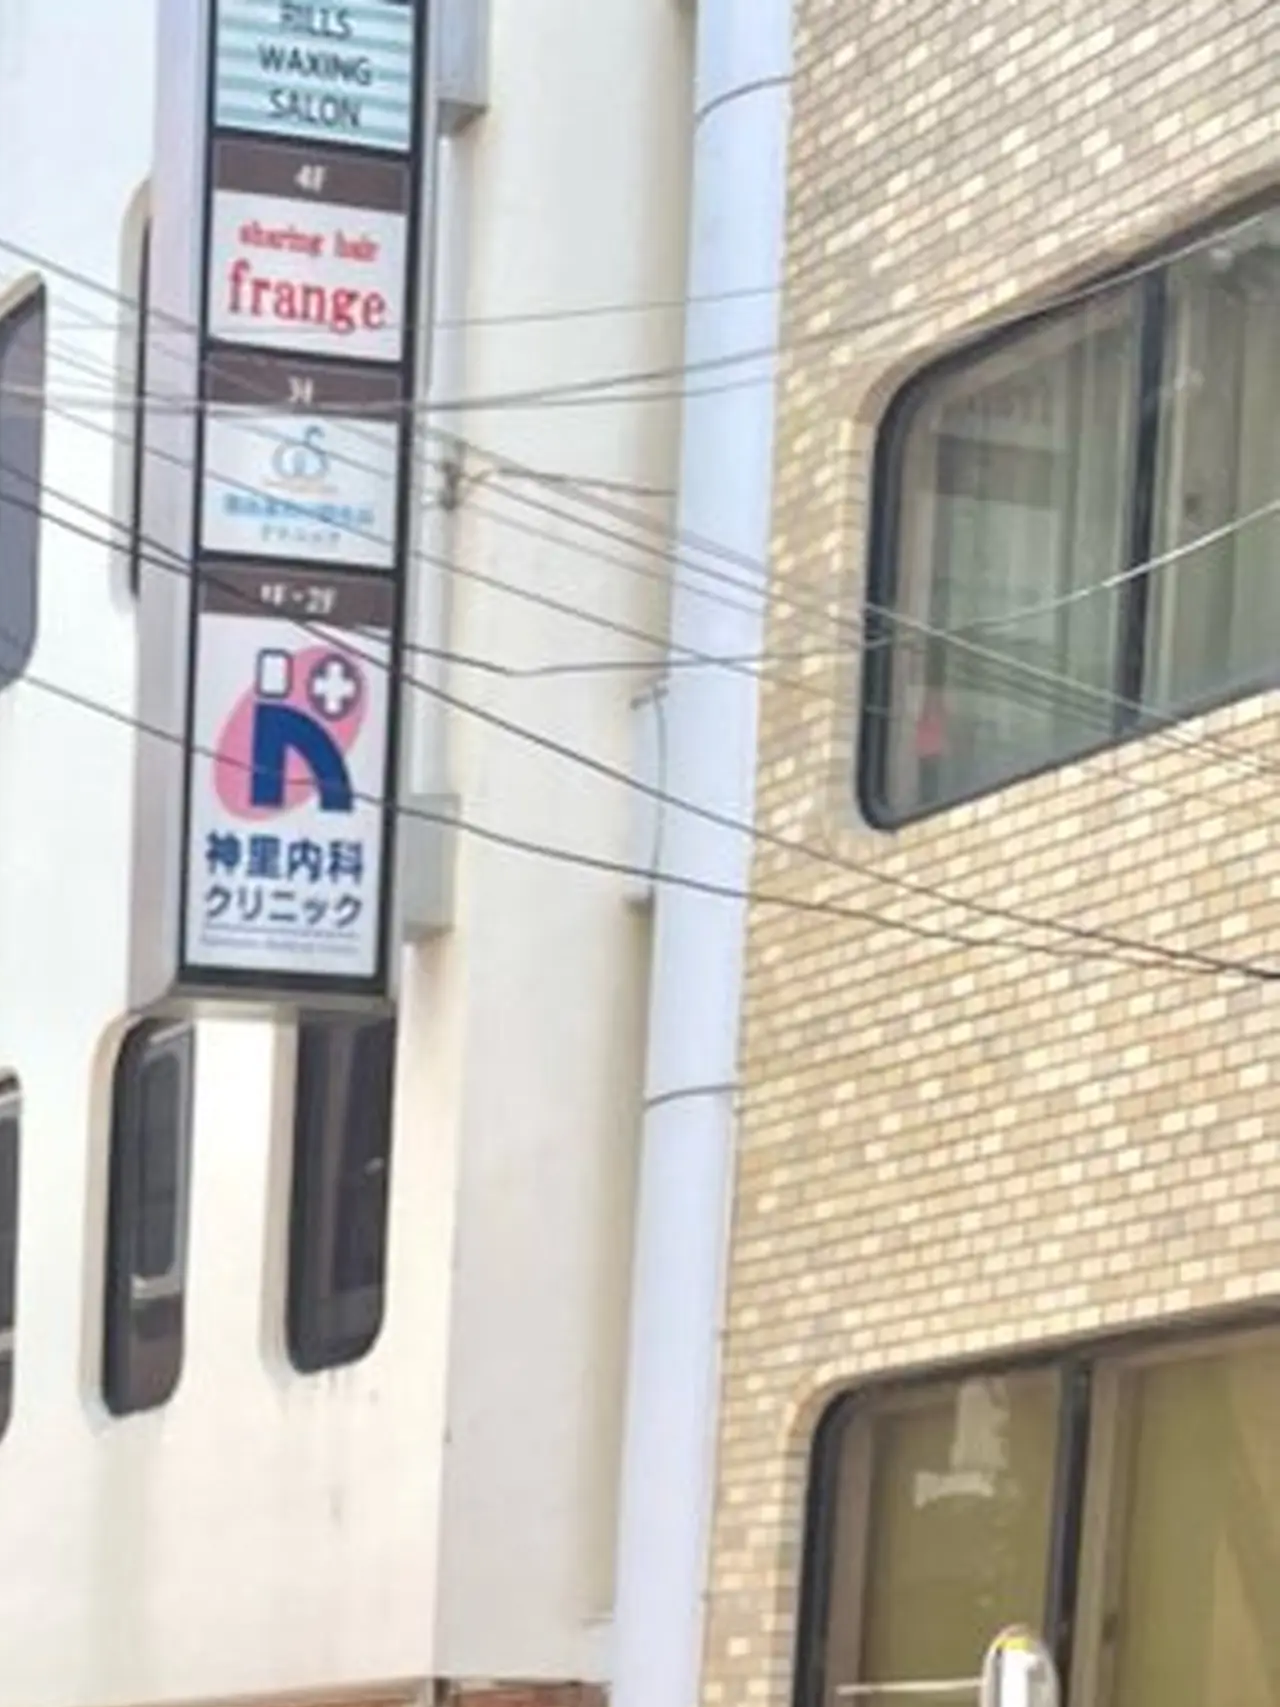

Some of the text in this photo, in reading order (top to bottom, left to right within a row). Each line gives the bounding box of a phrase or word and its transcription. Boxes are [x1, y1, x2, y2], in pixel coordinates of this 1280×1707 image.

[258, 44, 372, 86] WAXING
[268, 88, 361, 128] SALON
[228, 258, 387, 336] frange
[205, 885, 363, 929] クリニック
